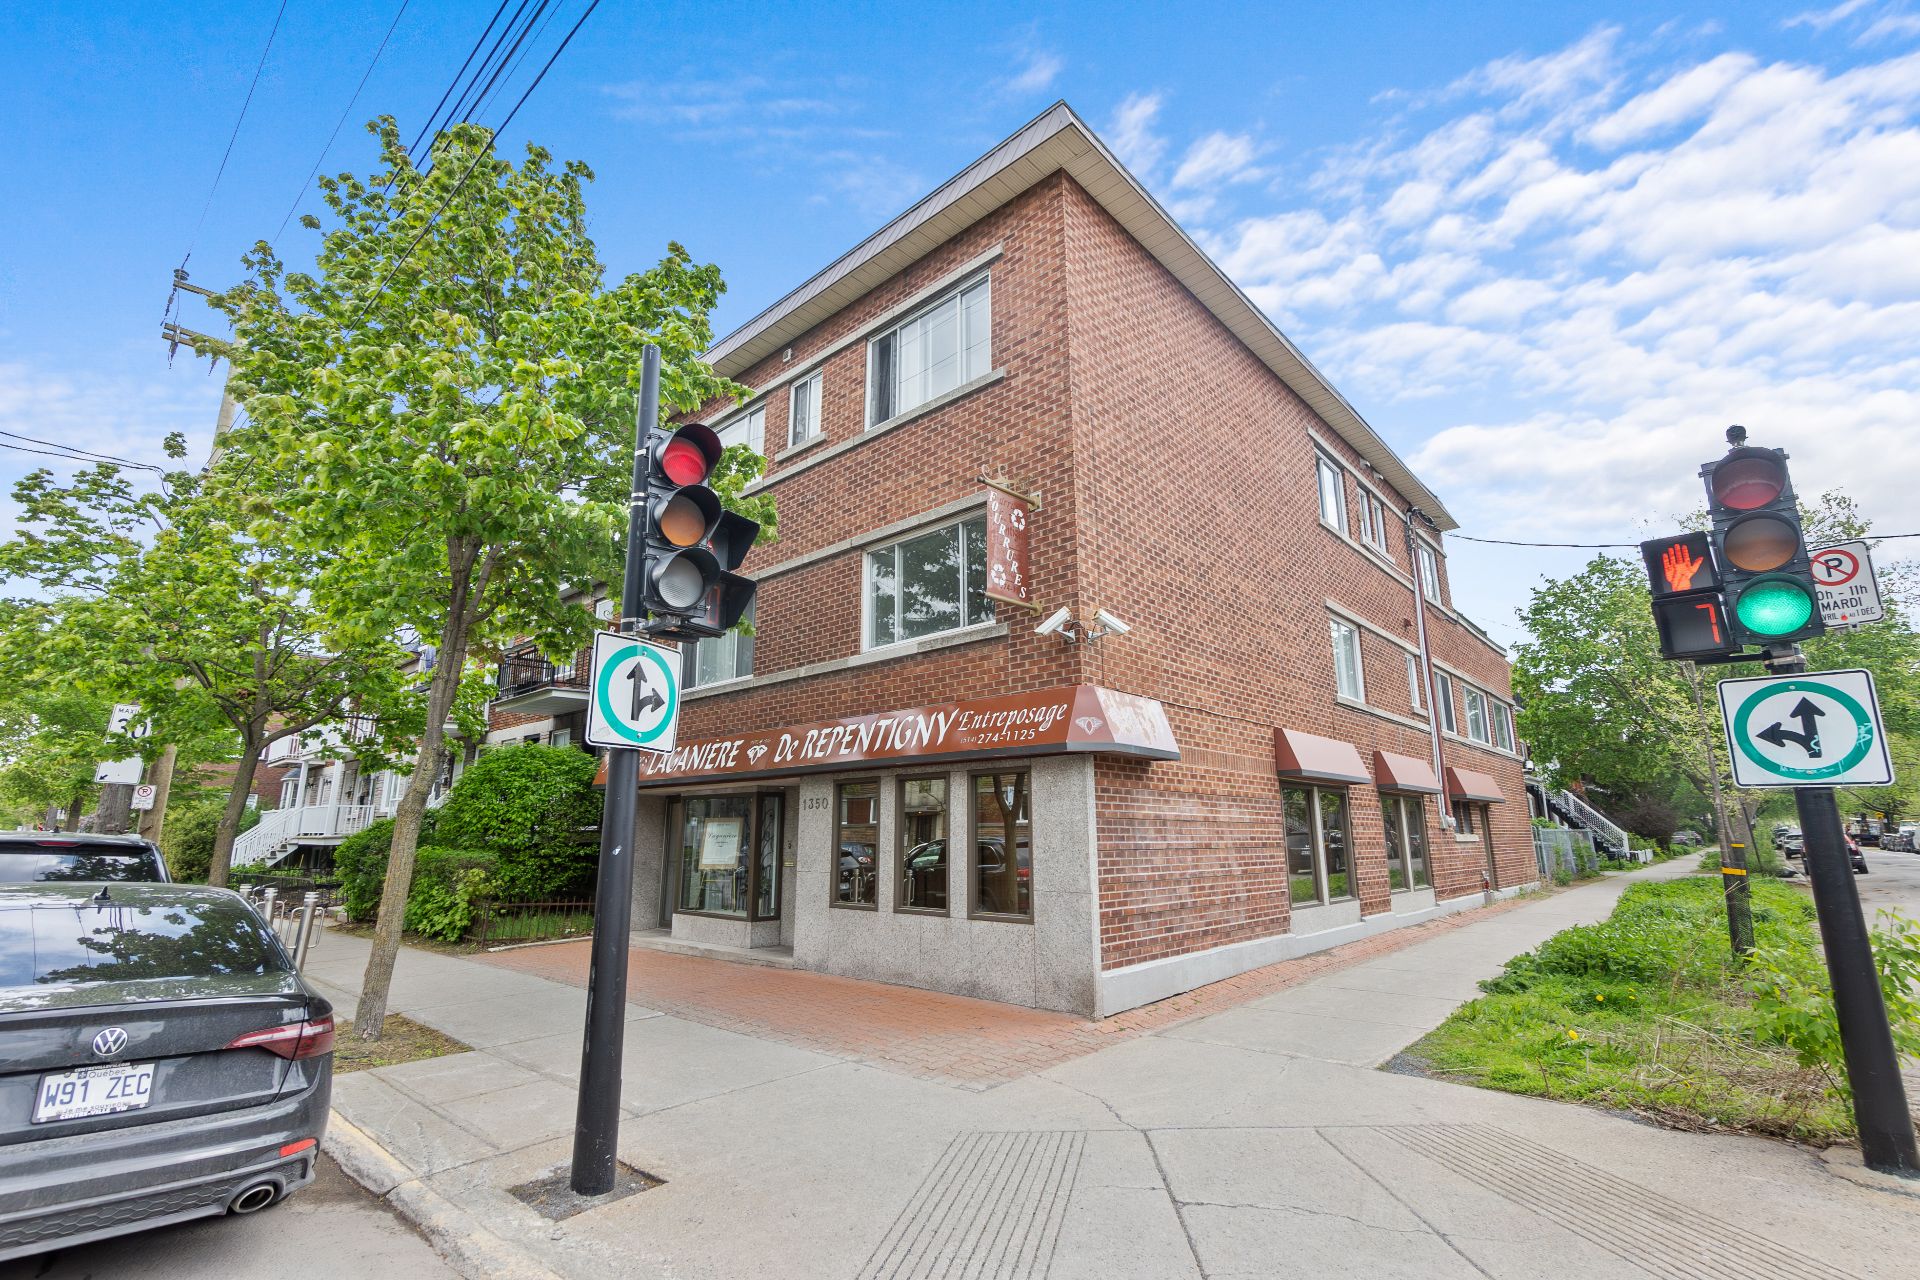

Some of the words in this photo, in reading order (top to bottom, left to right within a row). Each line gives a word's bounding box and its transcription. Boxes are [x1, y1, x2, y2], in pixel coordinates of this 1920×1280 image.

[989, 490, 1027, 599] FOURRURES
[1848, 585, 1868, 596] 11h
[1821, 597, 1863, 612] MARDI
[1695, 603, 1721, 644] 7
[1822, 613, 1839, 621] VRIL
[800, 708, 960, 759] REPENTIGNY
[958, 703, 1067, 736] Entreposage
[977, 729, 1036, 744] 274-1125
[803, 797, 828, 811] 1350
[88, 1068, 126, 1079] Québec
[44, 1079, 90, 1108] W91
[106, 1073, 151, 1099] ZEC
